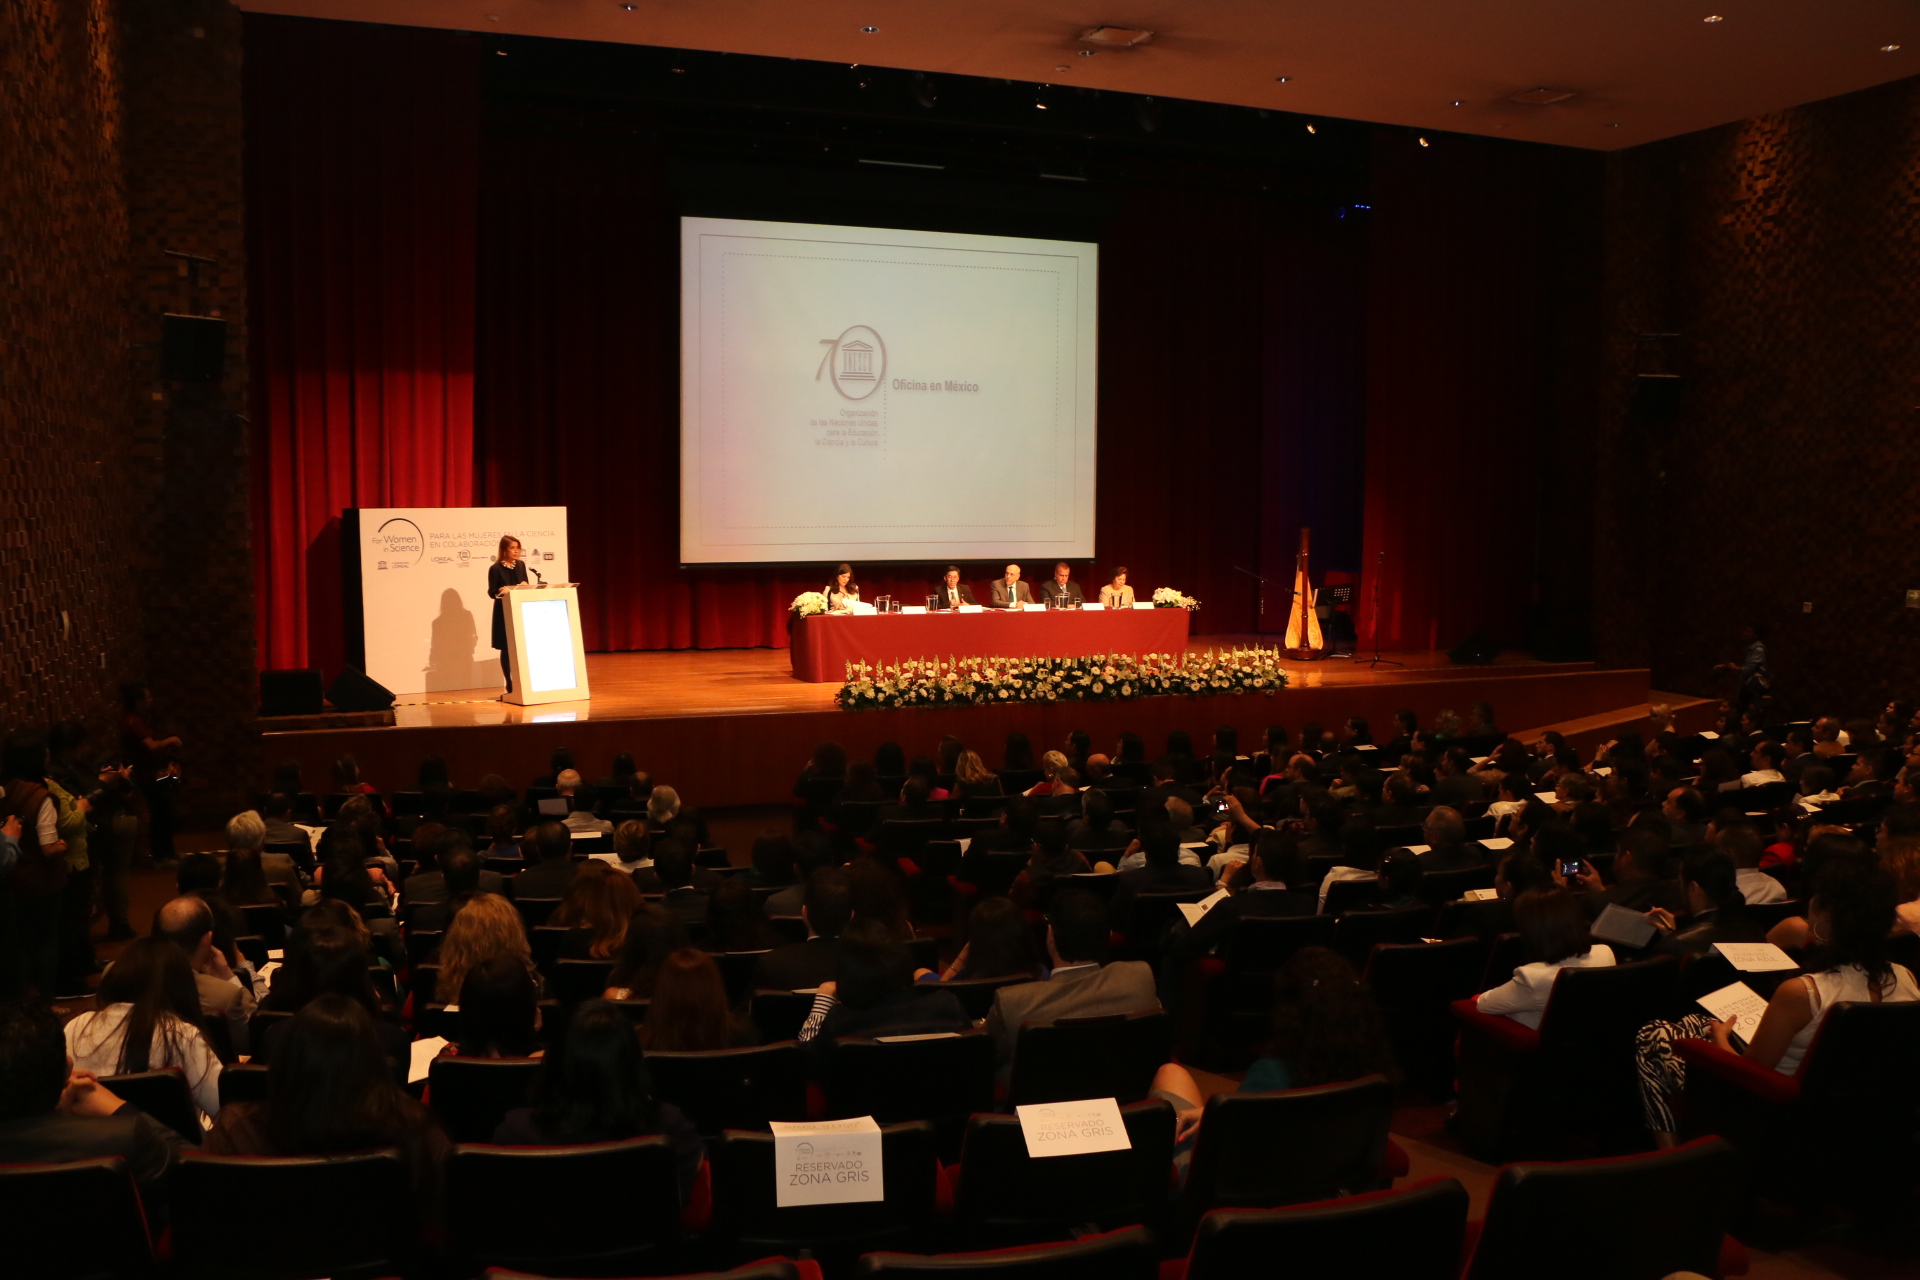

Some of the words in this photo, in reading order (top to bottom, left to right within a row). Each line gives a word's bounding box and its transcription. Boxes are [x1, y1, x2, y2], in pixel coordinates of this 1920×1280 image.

[892, 378, 927, 391] Oficina
[929, 382, 942, 391] en
[944, 380, 979, 392] México
[839, 408, 878, 418] Organización
[383, 535, 417, 544] Women
[390, 543, 420, 552] Science
[1714, 994, 1755, 1013] CEREMONIA
[1735, 1001, 1764, 1013] MUJERES
[1741, 997, 1760, 1007] PARA
[1743, 1004, 1767, 1016] CIENCIA
[1040, 1119, 1105, 1131] RESERVADO
[1036, 1130, 1078, 1141] ZONA
[1081, 1126, 1114, 1138] GRIS
[795, 1160, 863, 1172] RESERVADO
[789, 1173, 832, 1186] ZONA
[836, 1170, 870, 1183] GRIS
